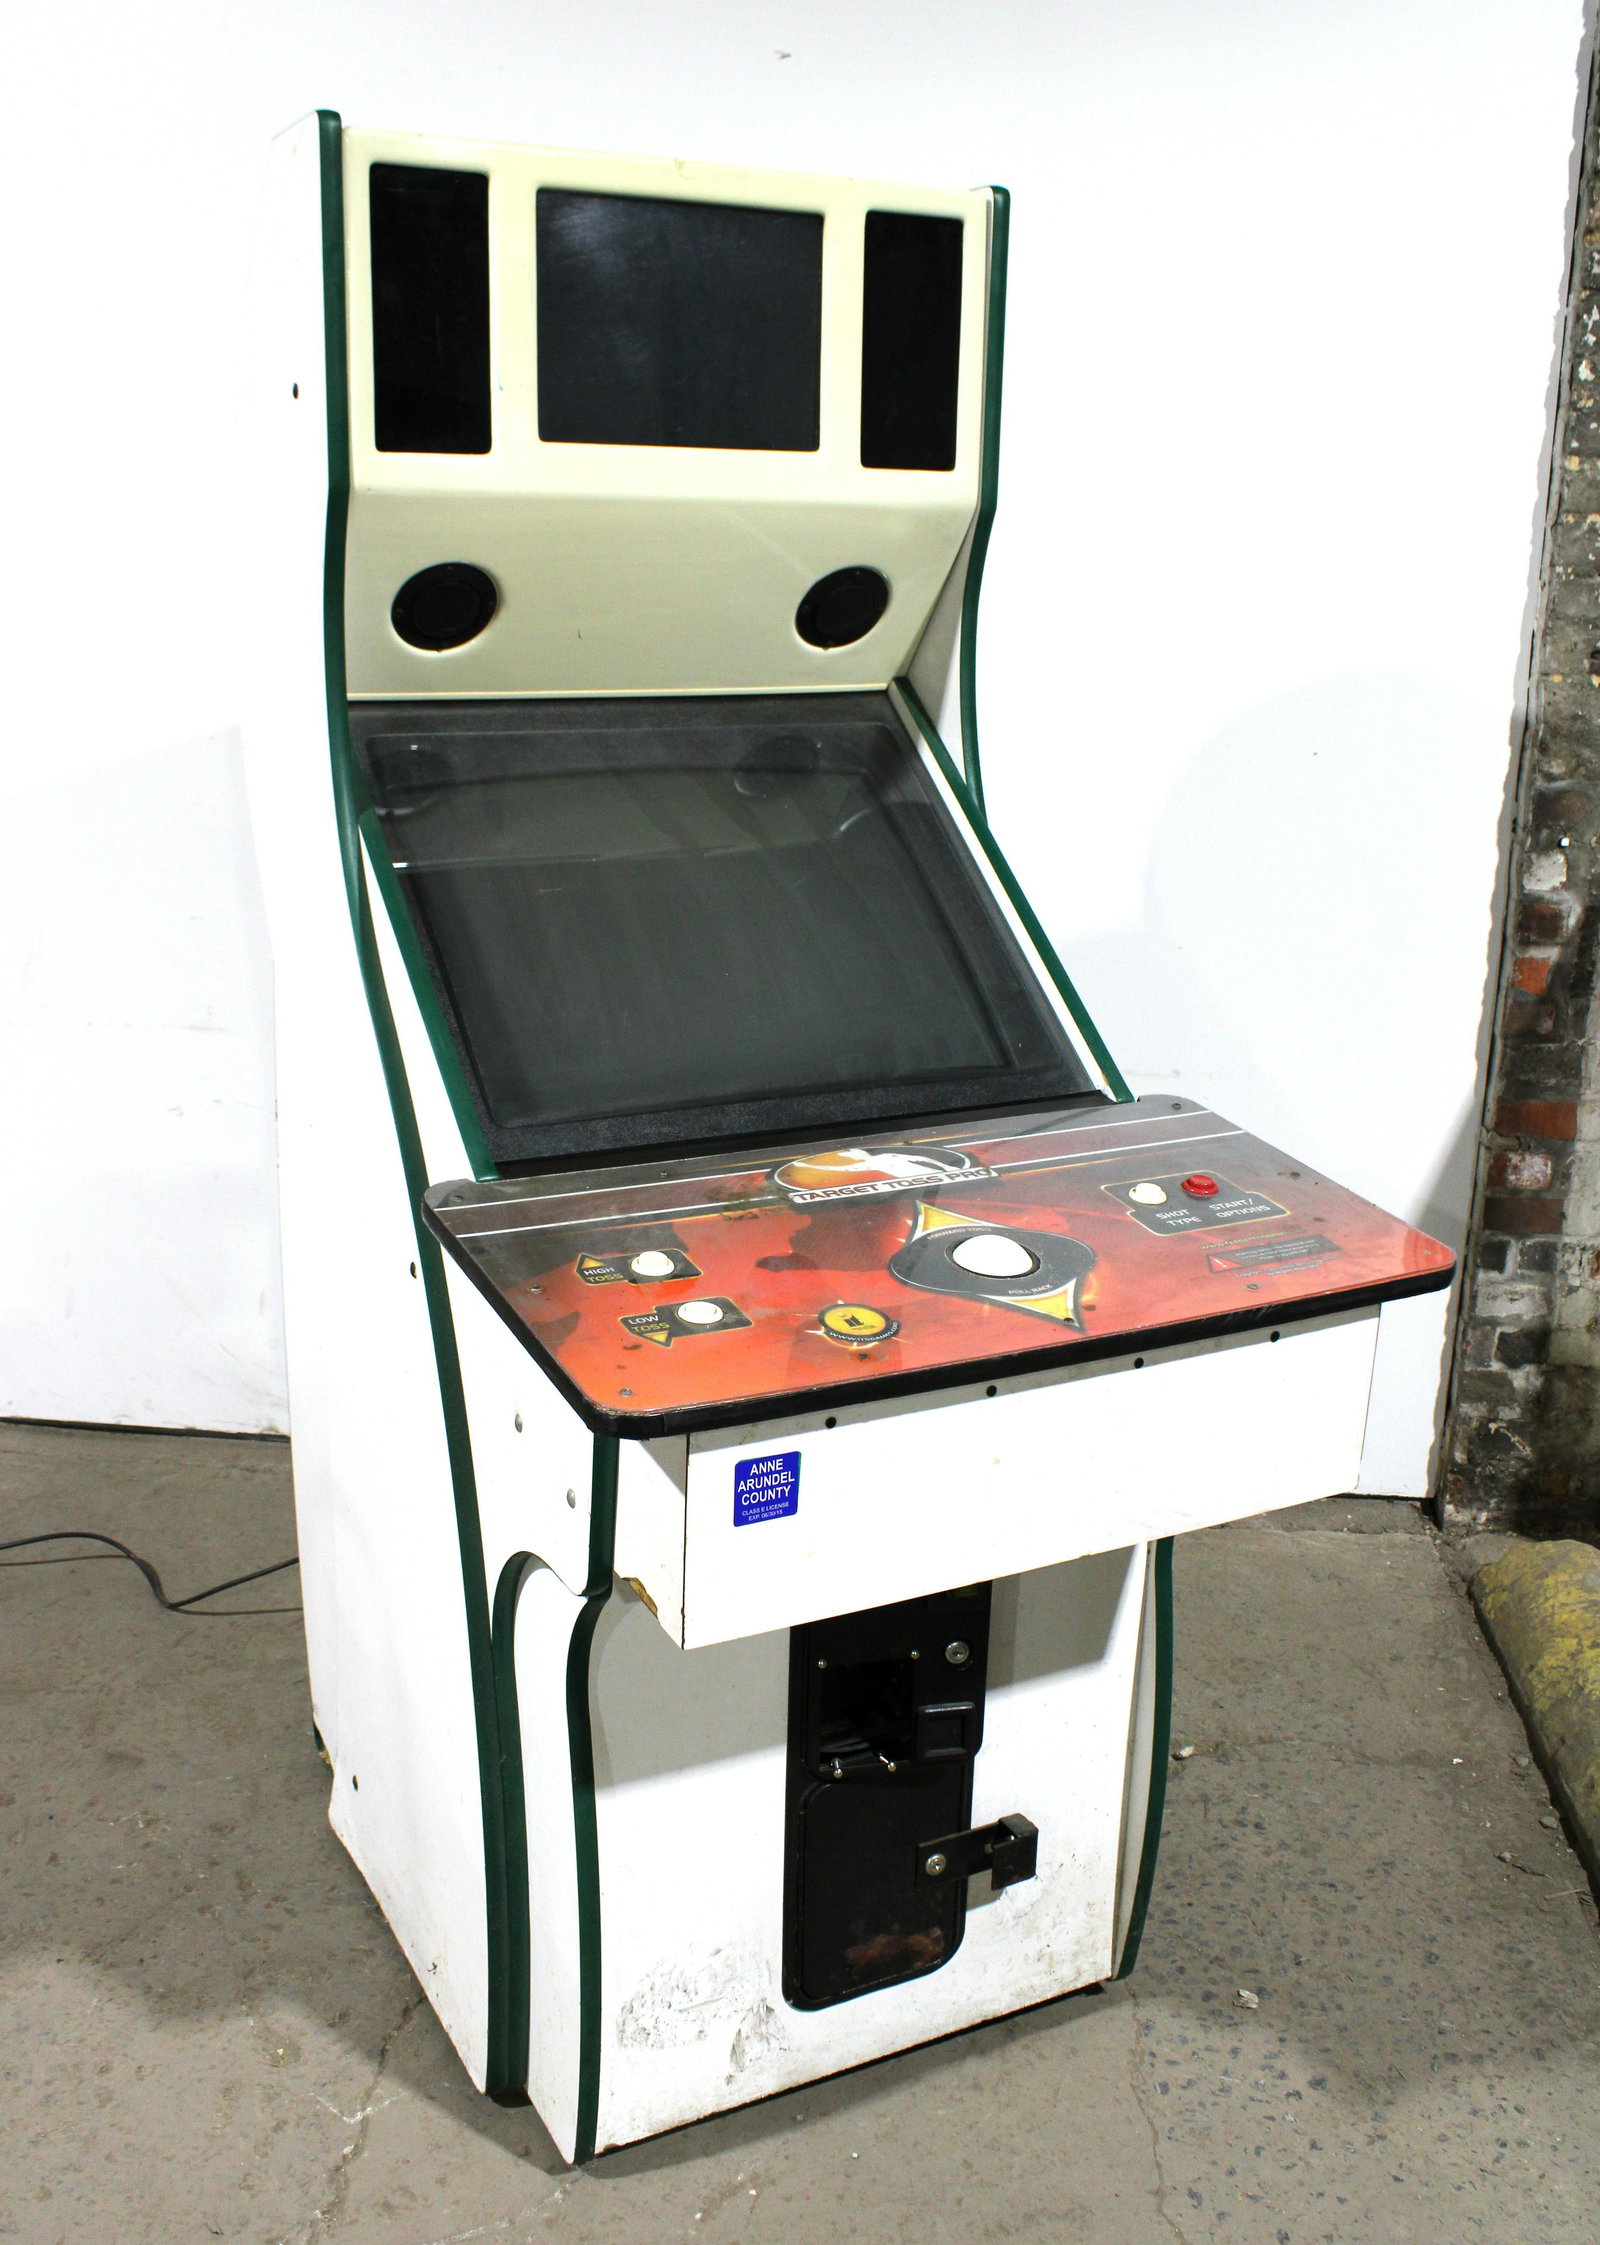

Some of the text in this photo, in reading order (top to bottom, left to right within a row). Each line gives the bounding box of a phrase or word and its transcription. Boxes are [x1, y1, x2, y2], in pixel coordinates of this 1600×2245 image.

[793, 1168, 992, 1202] TARGET TOSS PRO
[1208, 1198, 1254, 1211] START/
[1155, 1208, 1190, 1221] SHOT
[1215, 1204, 1271, 1219] OPTIONS
[1166, 1216, 1202, 1227] TYPE
[584, 1266, 616, 1276] HIGH
[586, 1273, 625, 1283] TOSS
[628, 1315, 660, 1325] LOW
[631, 1322, 670, 1332] TOSS
[749, 1458, 784, 1476] ANNE
[737, 1470, 796, 1493] ARUNDEL
[741, 1484, 792, 1506] COUNTY
[741, 1507, 760, 1517] CLASS
[766, 1501, 790, 1512] LICENSE
